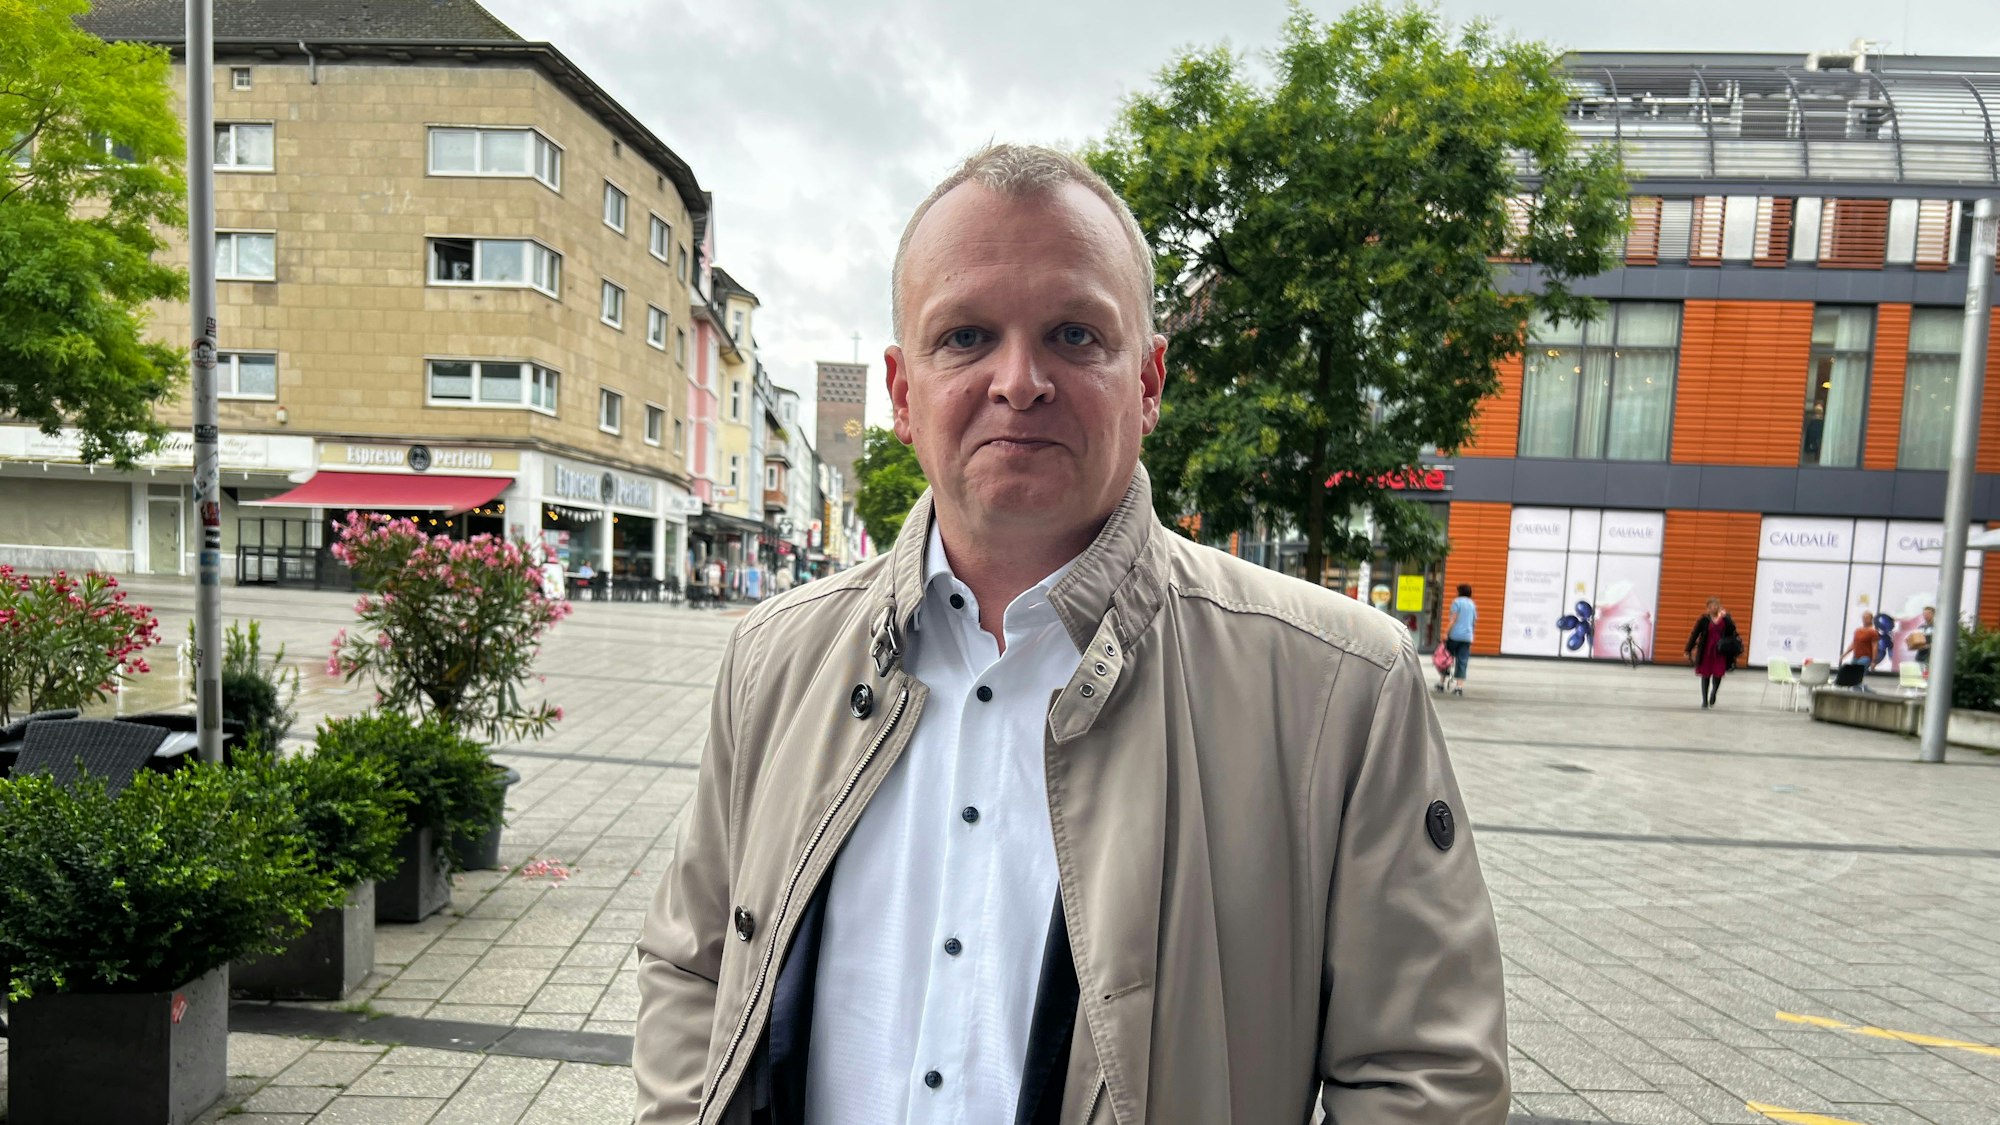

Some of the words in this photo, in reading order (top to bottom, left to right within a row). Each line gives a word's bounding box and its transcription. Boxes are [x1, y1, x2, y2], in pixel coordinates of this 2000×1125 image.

[160, 437, 193, 451] oden
[347, 446, 405, 466] Espresso
[1769, 530, 1839, 548] CAUDALÍE
